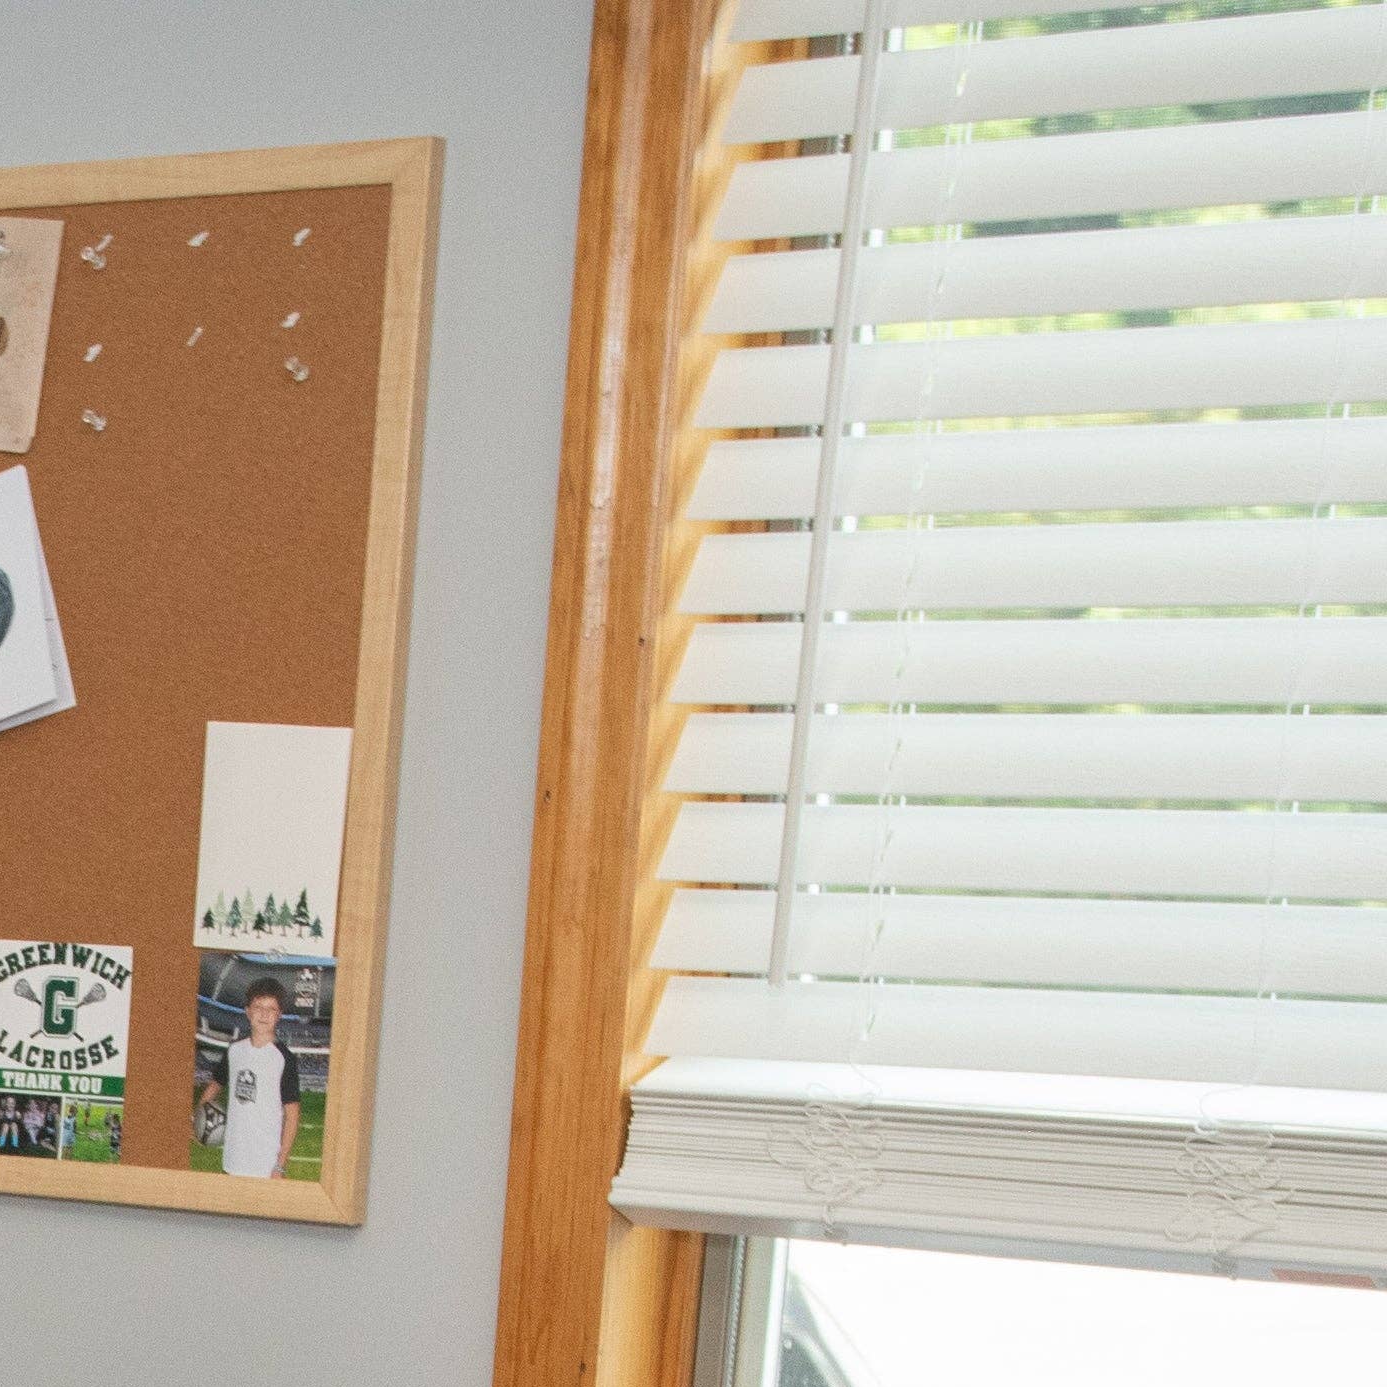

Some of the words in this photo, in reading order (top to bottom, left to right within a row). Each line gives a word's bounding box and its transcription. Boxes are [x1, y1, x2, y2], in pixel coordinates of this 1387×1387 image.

[43, 976, 80, 1038] G
[2, 1070, 62, 1091] THANK
[68, 1075, 103, 1094] YOU
